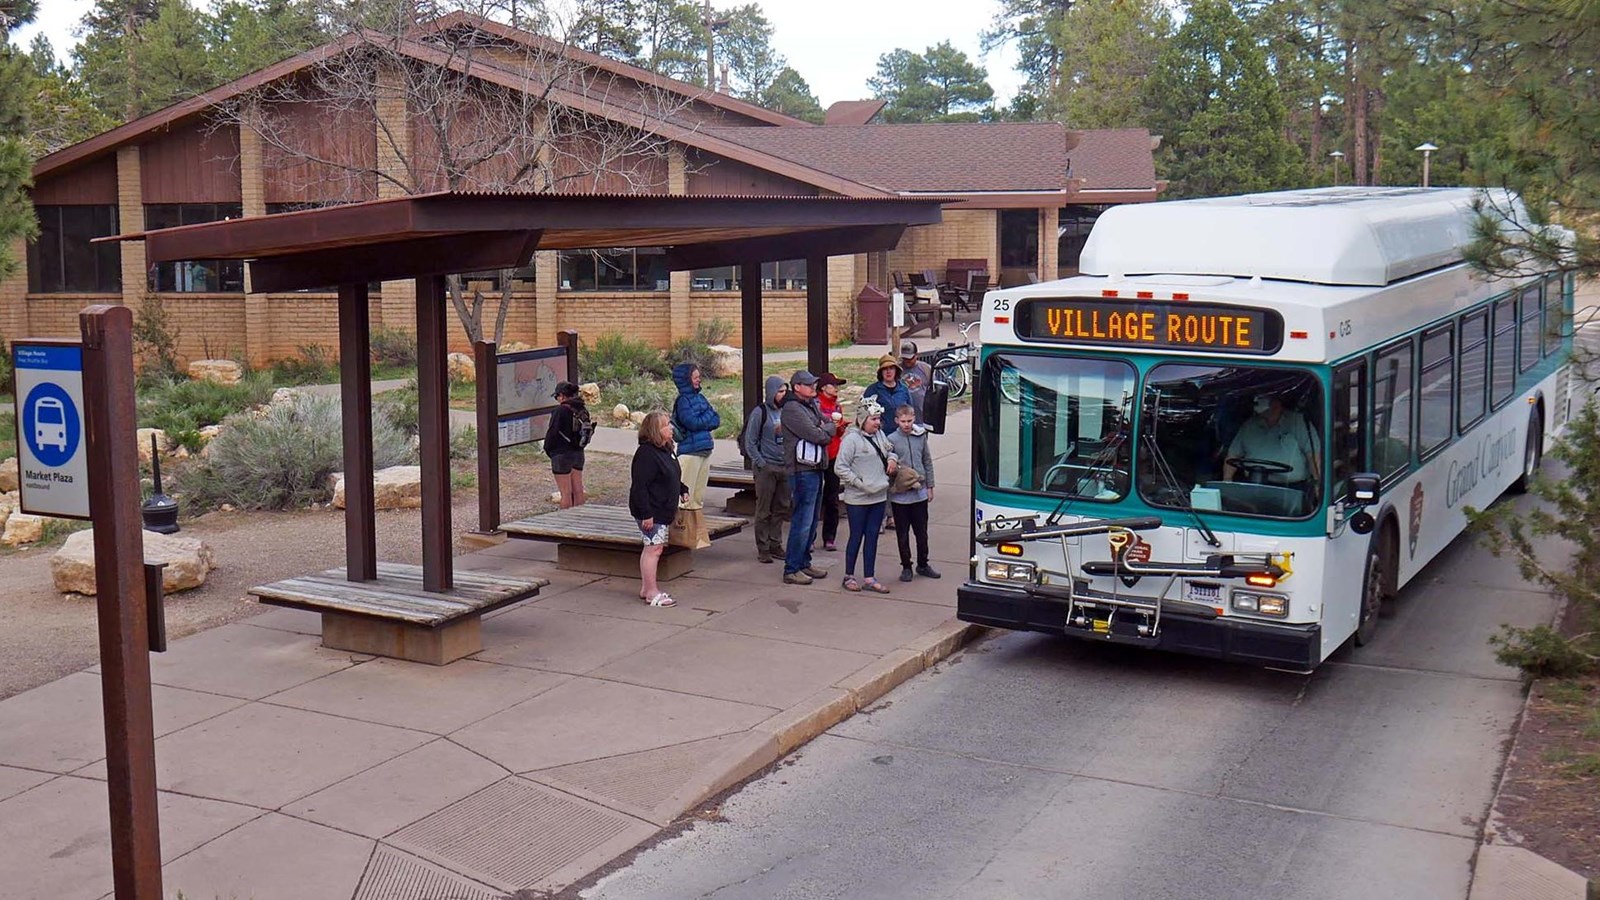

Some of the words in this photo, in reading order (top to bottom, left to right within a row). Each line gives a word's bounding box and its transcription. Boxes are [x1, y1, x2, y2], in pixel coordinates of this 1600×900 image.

[993, 299, 1010, 311] 25
[1047, 308, 1155, 341] VILLAGE
[1167, 314, 1251, 346] ROUTE
[25, 470, 51, 481] Market
[53, 472, 73, 483] Plaza
[1446, 440, 1481, 509] Grand
[1482, 427, 1517, 479] Canyon
